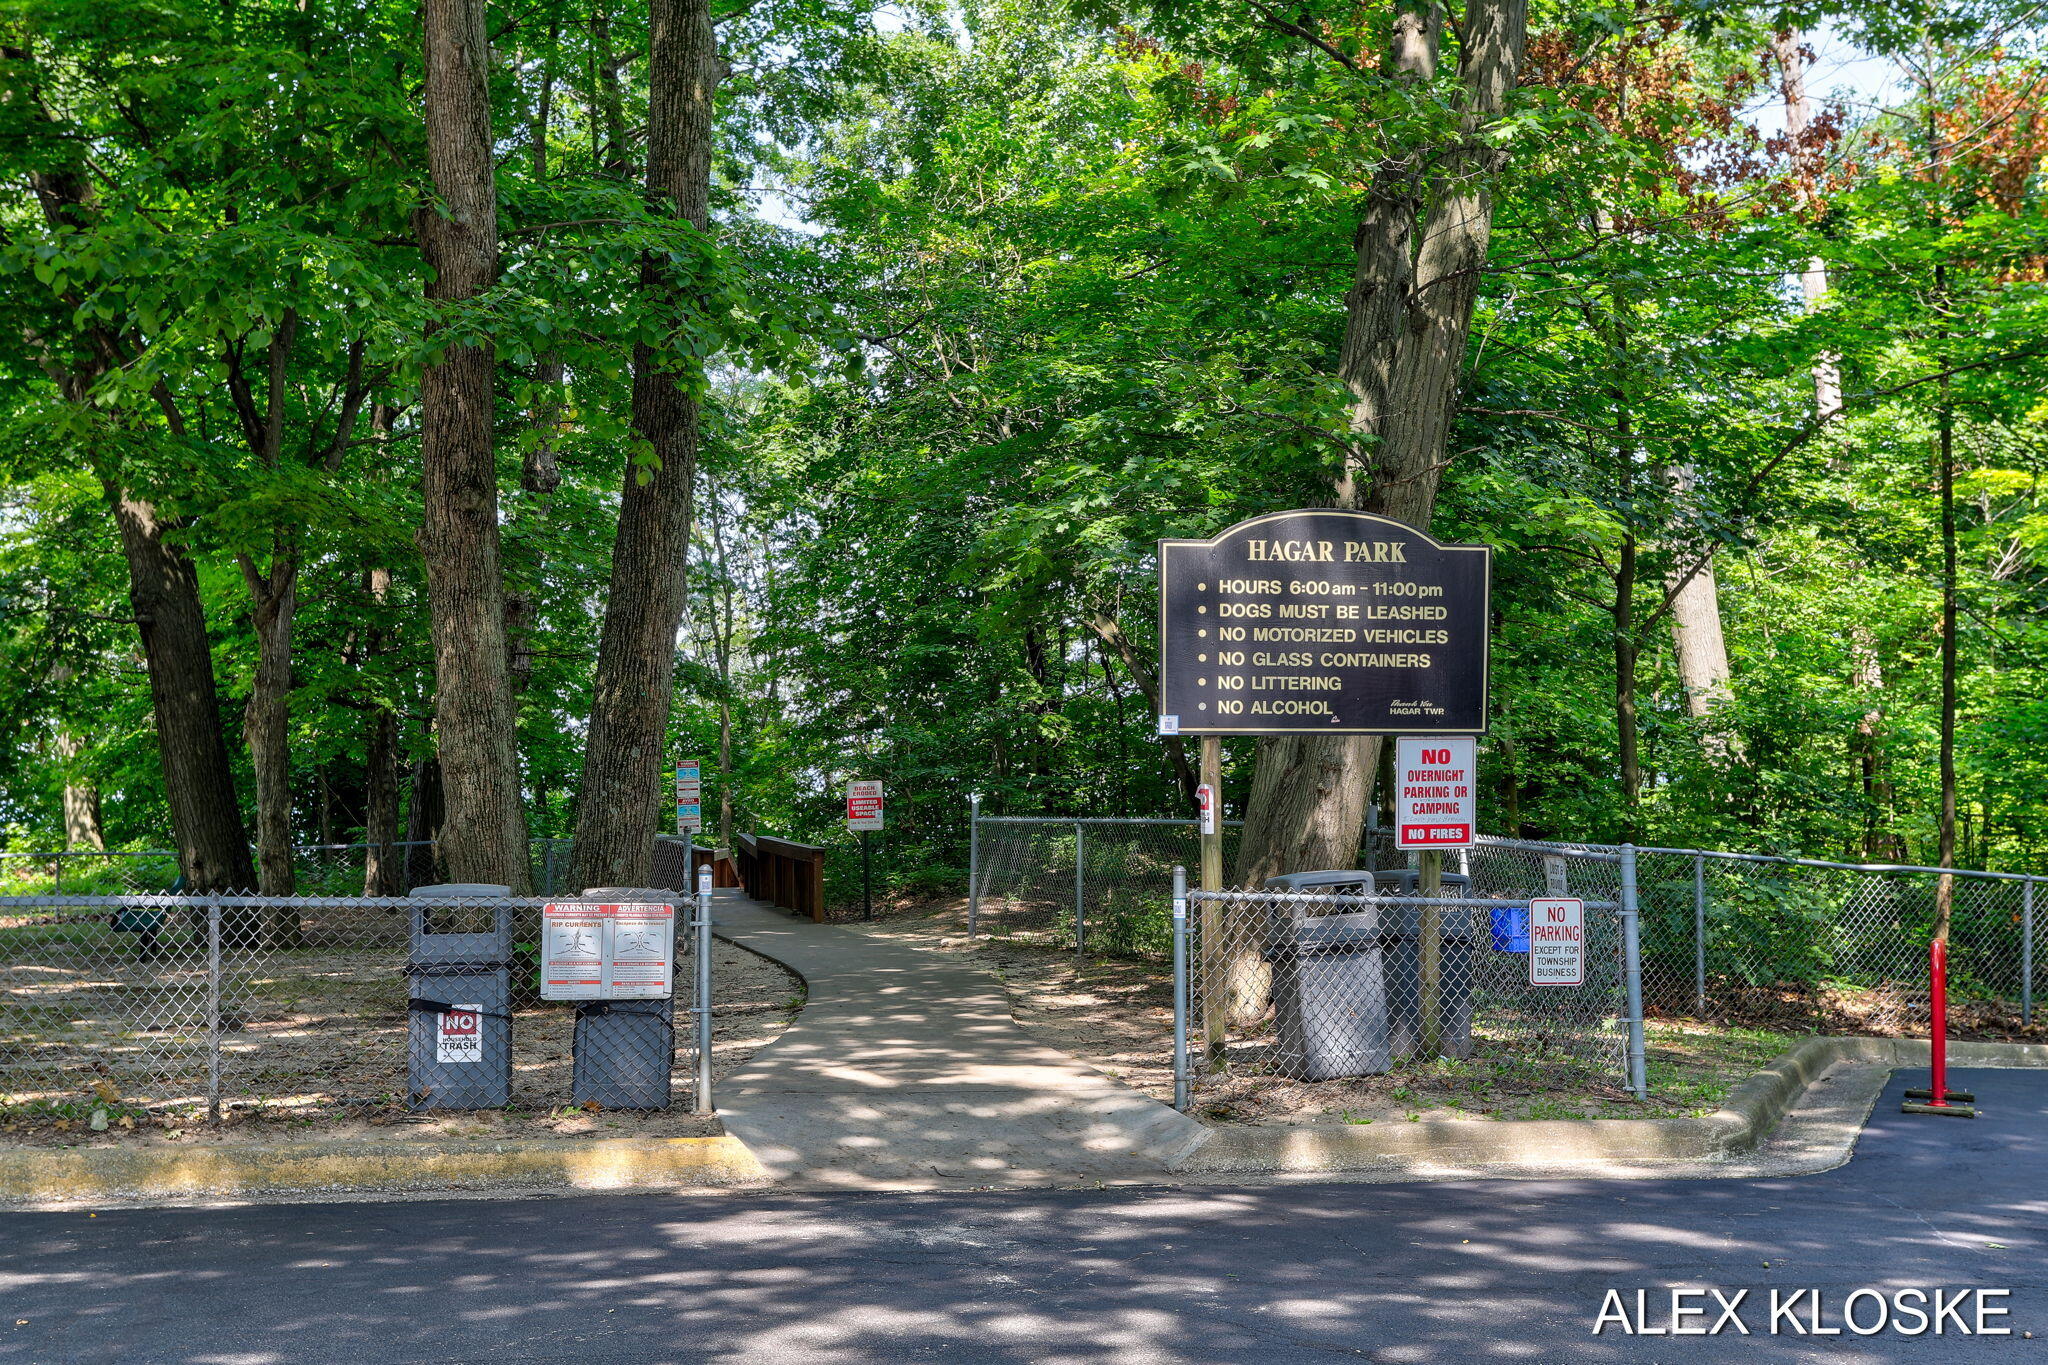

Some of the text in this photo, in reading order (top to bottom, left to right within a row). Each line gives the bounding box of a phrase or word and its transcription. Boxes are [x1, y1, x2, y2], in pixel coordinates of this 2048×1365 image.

[1248, 540, 1406, 563] HAGAR PARK
[1219, 580, 1281, 594] HOURS
[1219, 604, 1447, 620] DOGS MUST BE LEASHED
[1219, 627, 1448, 644] NO MOTORIZED VEHICLES
[1218, 652, 1431, 668] NO GLASS CONTAINERS
[1218, 676, 1342, 690] NO LITTERING
[1218, 701, 1333, 714] NO ALCOHOL
[1422, 749, 1451, 764] NO
[1408, 770, 1464, 782] OVERNIGHT
[1404, 786, 1467, 798] PARKING OR
[1412, 802, 1459, 815] CAMPING
[1408, 828, 1463, 839] NO FIRES
[1547, 907, 1565, 922] NO
[1535, 926, 1580, 941] PARKING
[1535, 946, 1563, 955] EXCEPT
[1537, 968, 1576, 977] BUSINESS
[446, 1015, 473, 1029] NO
